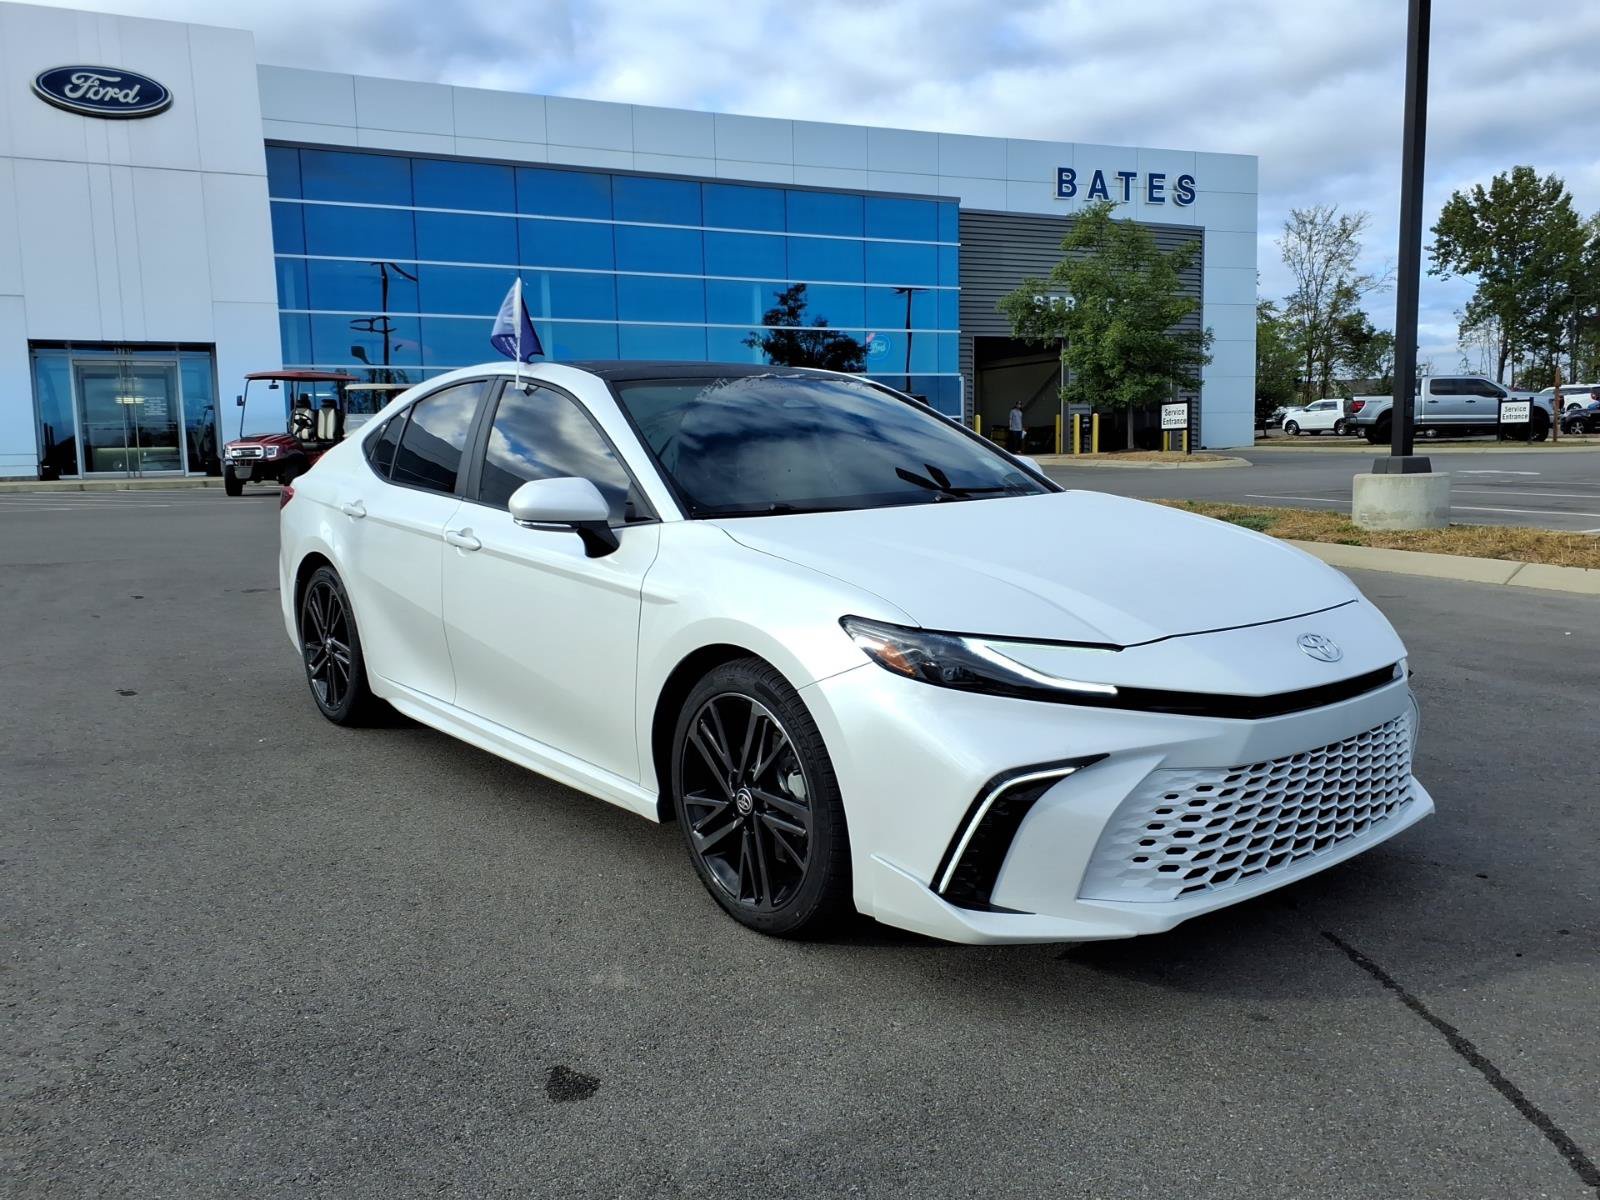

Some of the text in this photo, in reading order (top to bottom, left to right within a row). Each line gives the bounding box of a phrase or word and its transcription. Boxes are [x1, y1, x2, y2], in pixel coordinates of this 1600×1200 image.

[64, 72, 141, 104] Ford
[1056, 166, 1197, 205] BATES
[1164, 408, 1185, 417] Service
[1502, 413, 1529, 421] Entrance
[1162, 417, 1187, 426] Entrance
